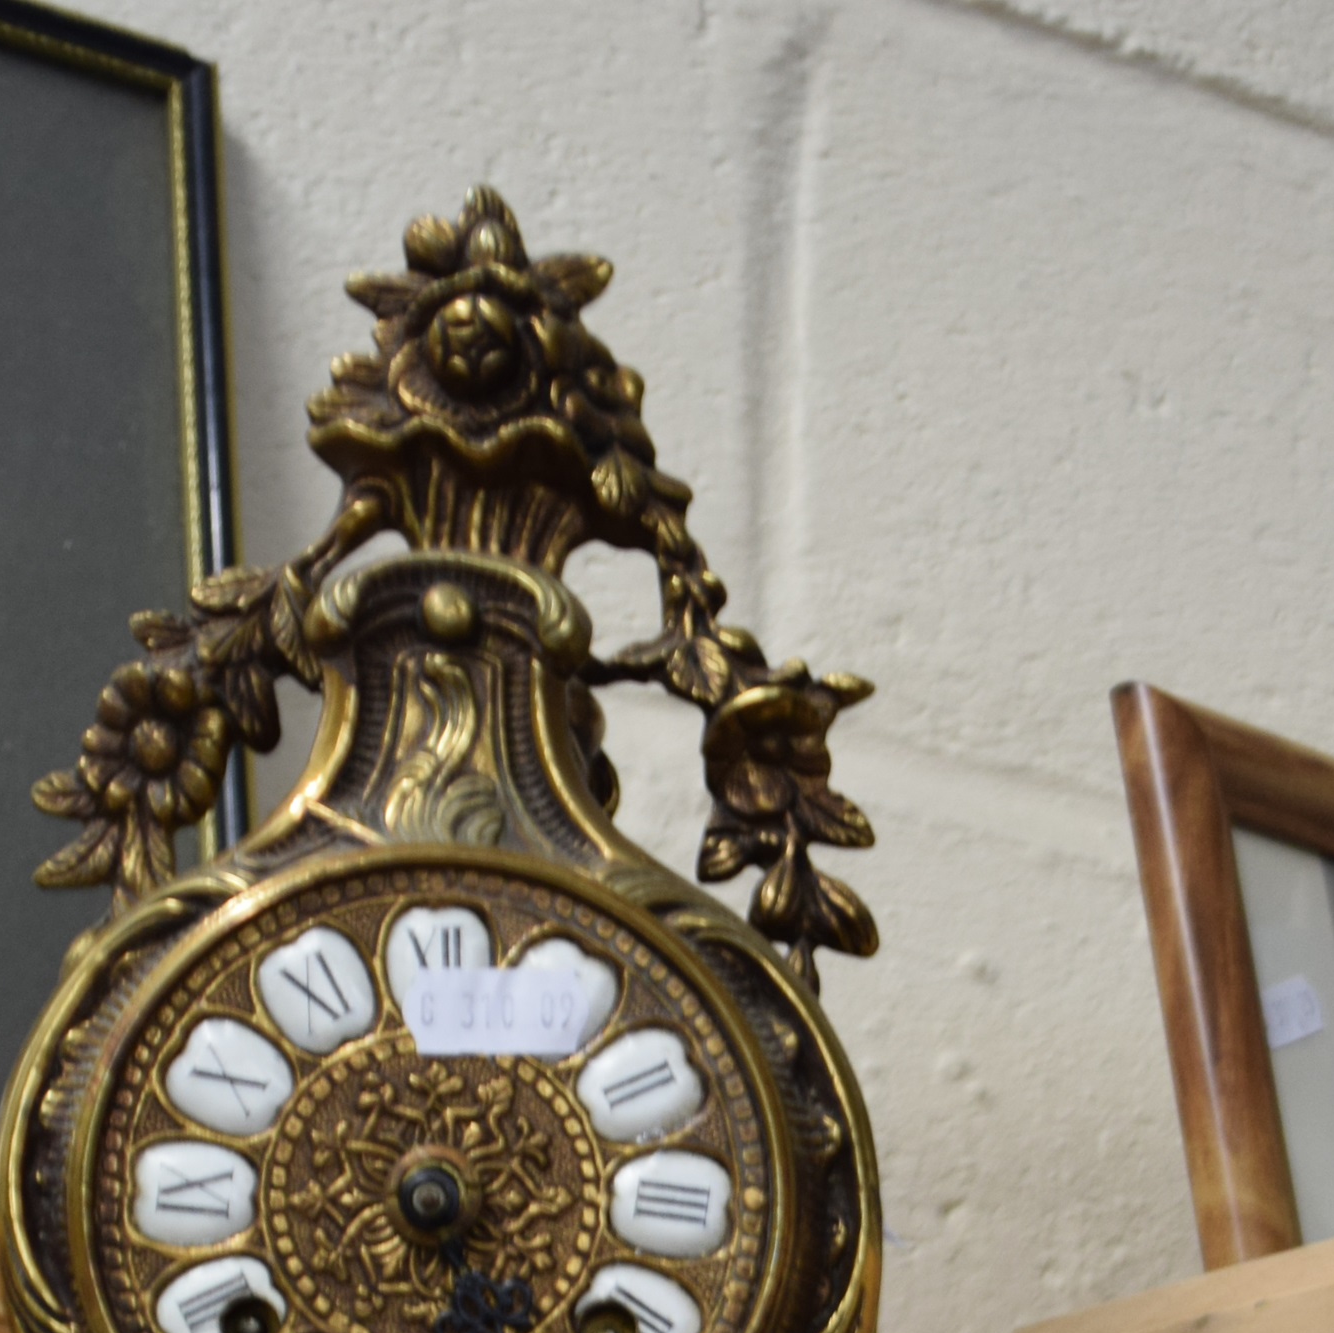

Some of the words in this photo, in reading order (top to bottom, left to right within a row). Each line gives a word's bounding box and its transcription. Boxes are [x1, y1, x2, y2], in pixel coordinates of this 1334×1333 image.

[279, 949, 351, 1036] XI
[540, 990, 575, 1030] 09
[190, 1043, 268, 1119] X
[603, 1058, 677, 1111] II
[633, 1178, 711, 1228] III
